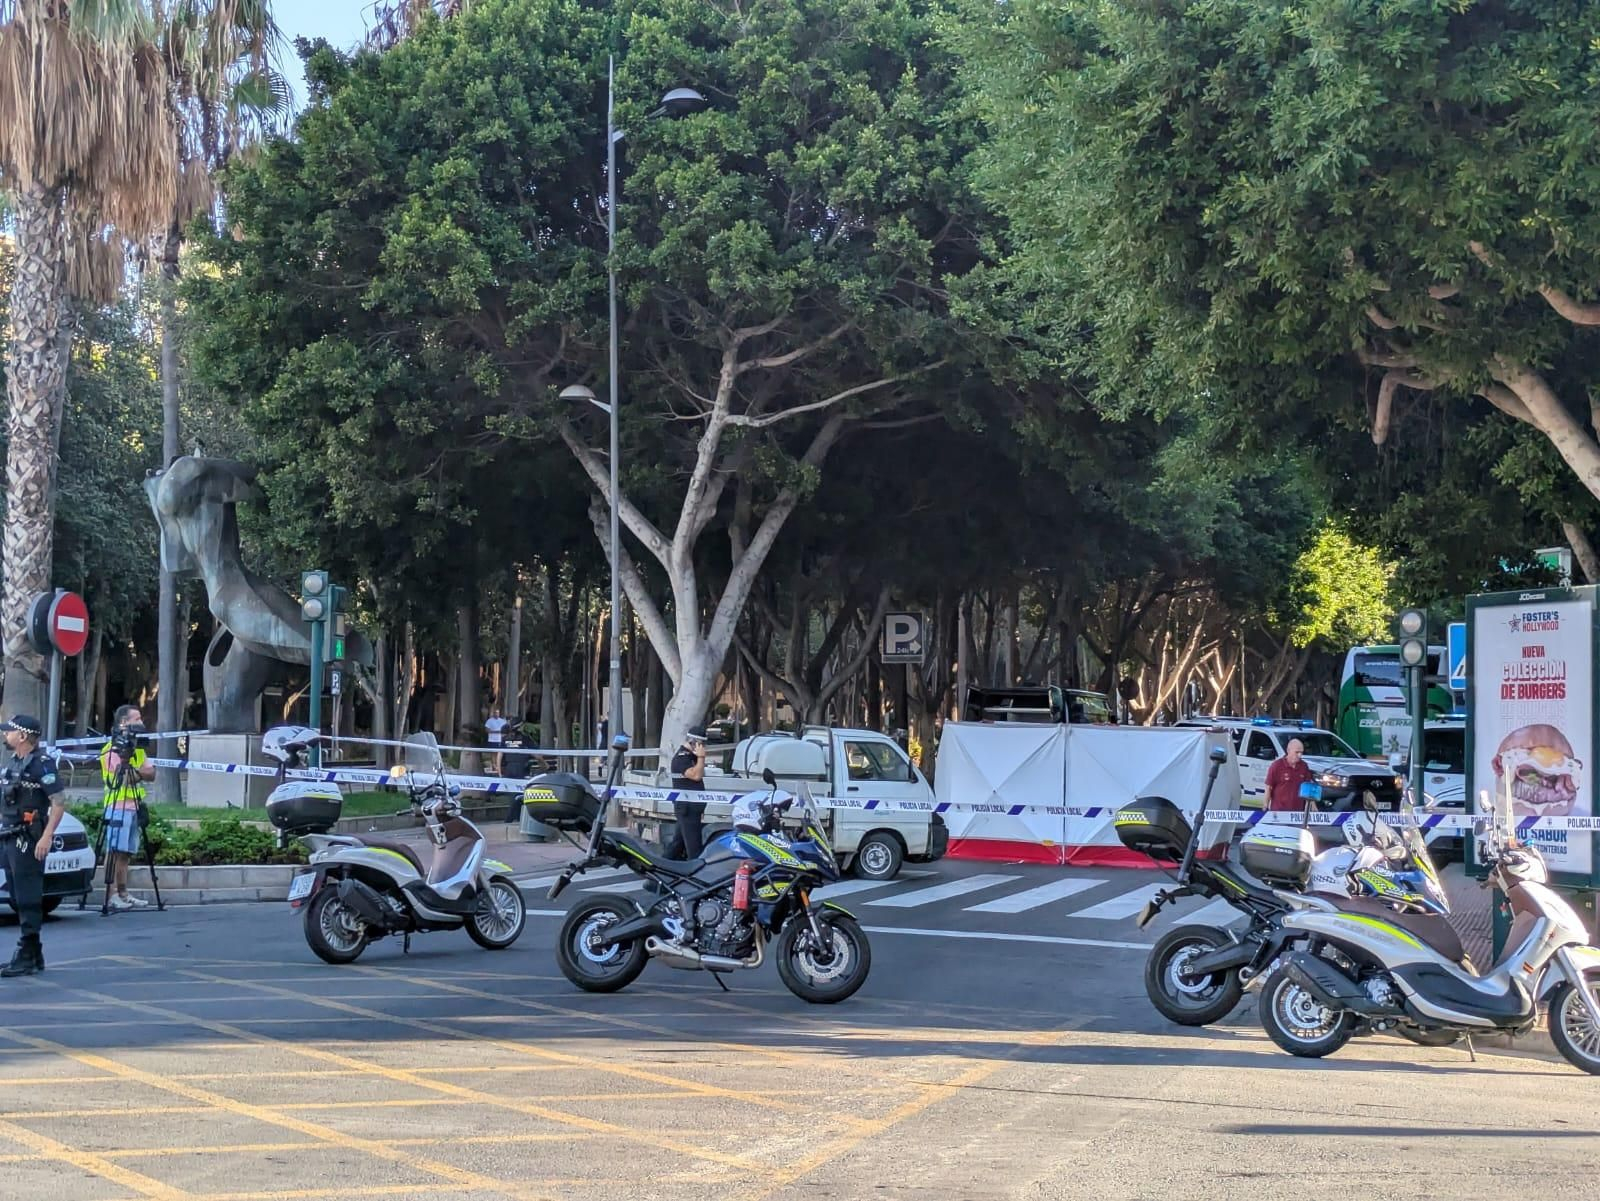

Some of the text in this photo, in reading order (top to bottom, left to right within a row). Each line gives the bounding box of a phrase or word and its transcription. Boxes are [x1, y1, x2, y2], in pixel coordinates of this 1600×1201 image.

[1522, 611, 1559, 622] FOSTER'S
[1522, 621, 1559, 632] HOLLYWOOD
[886, 615, 919, 654] P
[1522, 645, 1546, 658] NUEVA
[1501, 682, 1566, 700] DE BURGERS
[1200, 811, 1240, 821] POLICIA LOCAL
[1313, 813, 1331, 823] LOCAL
[1567, 818, 1592, 828] POLICIA
